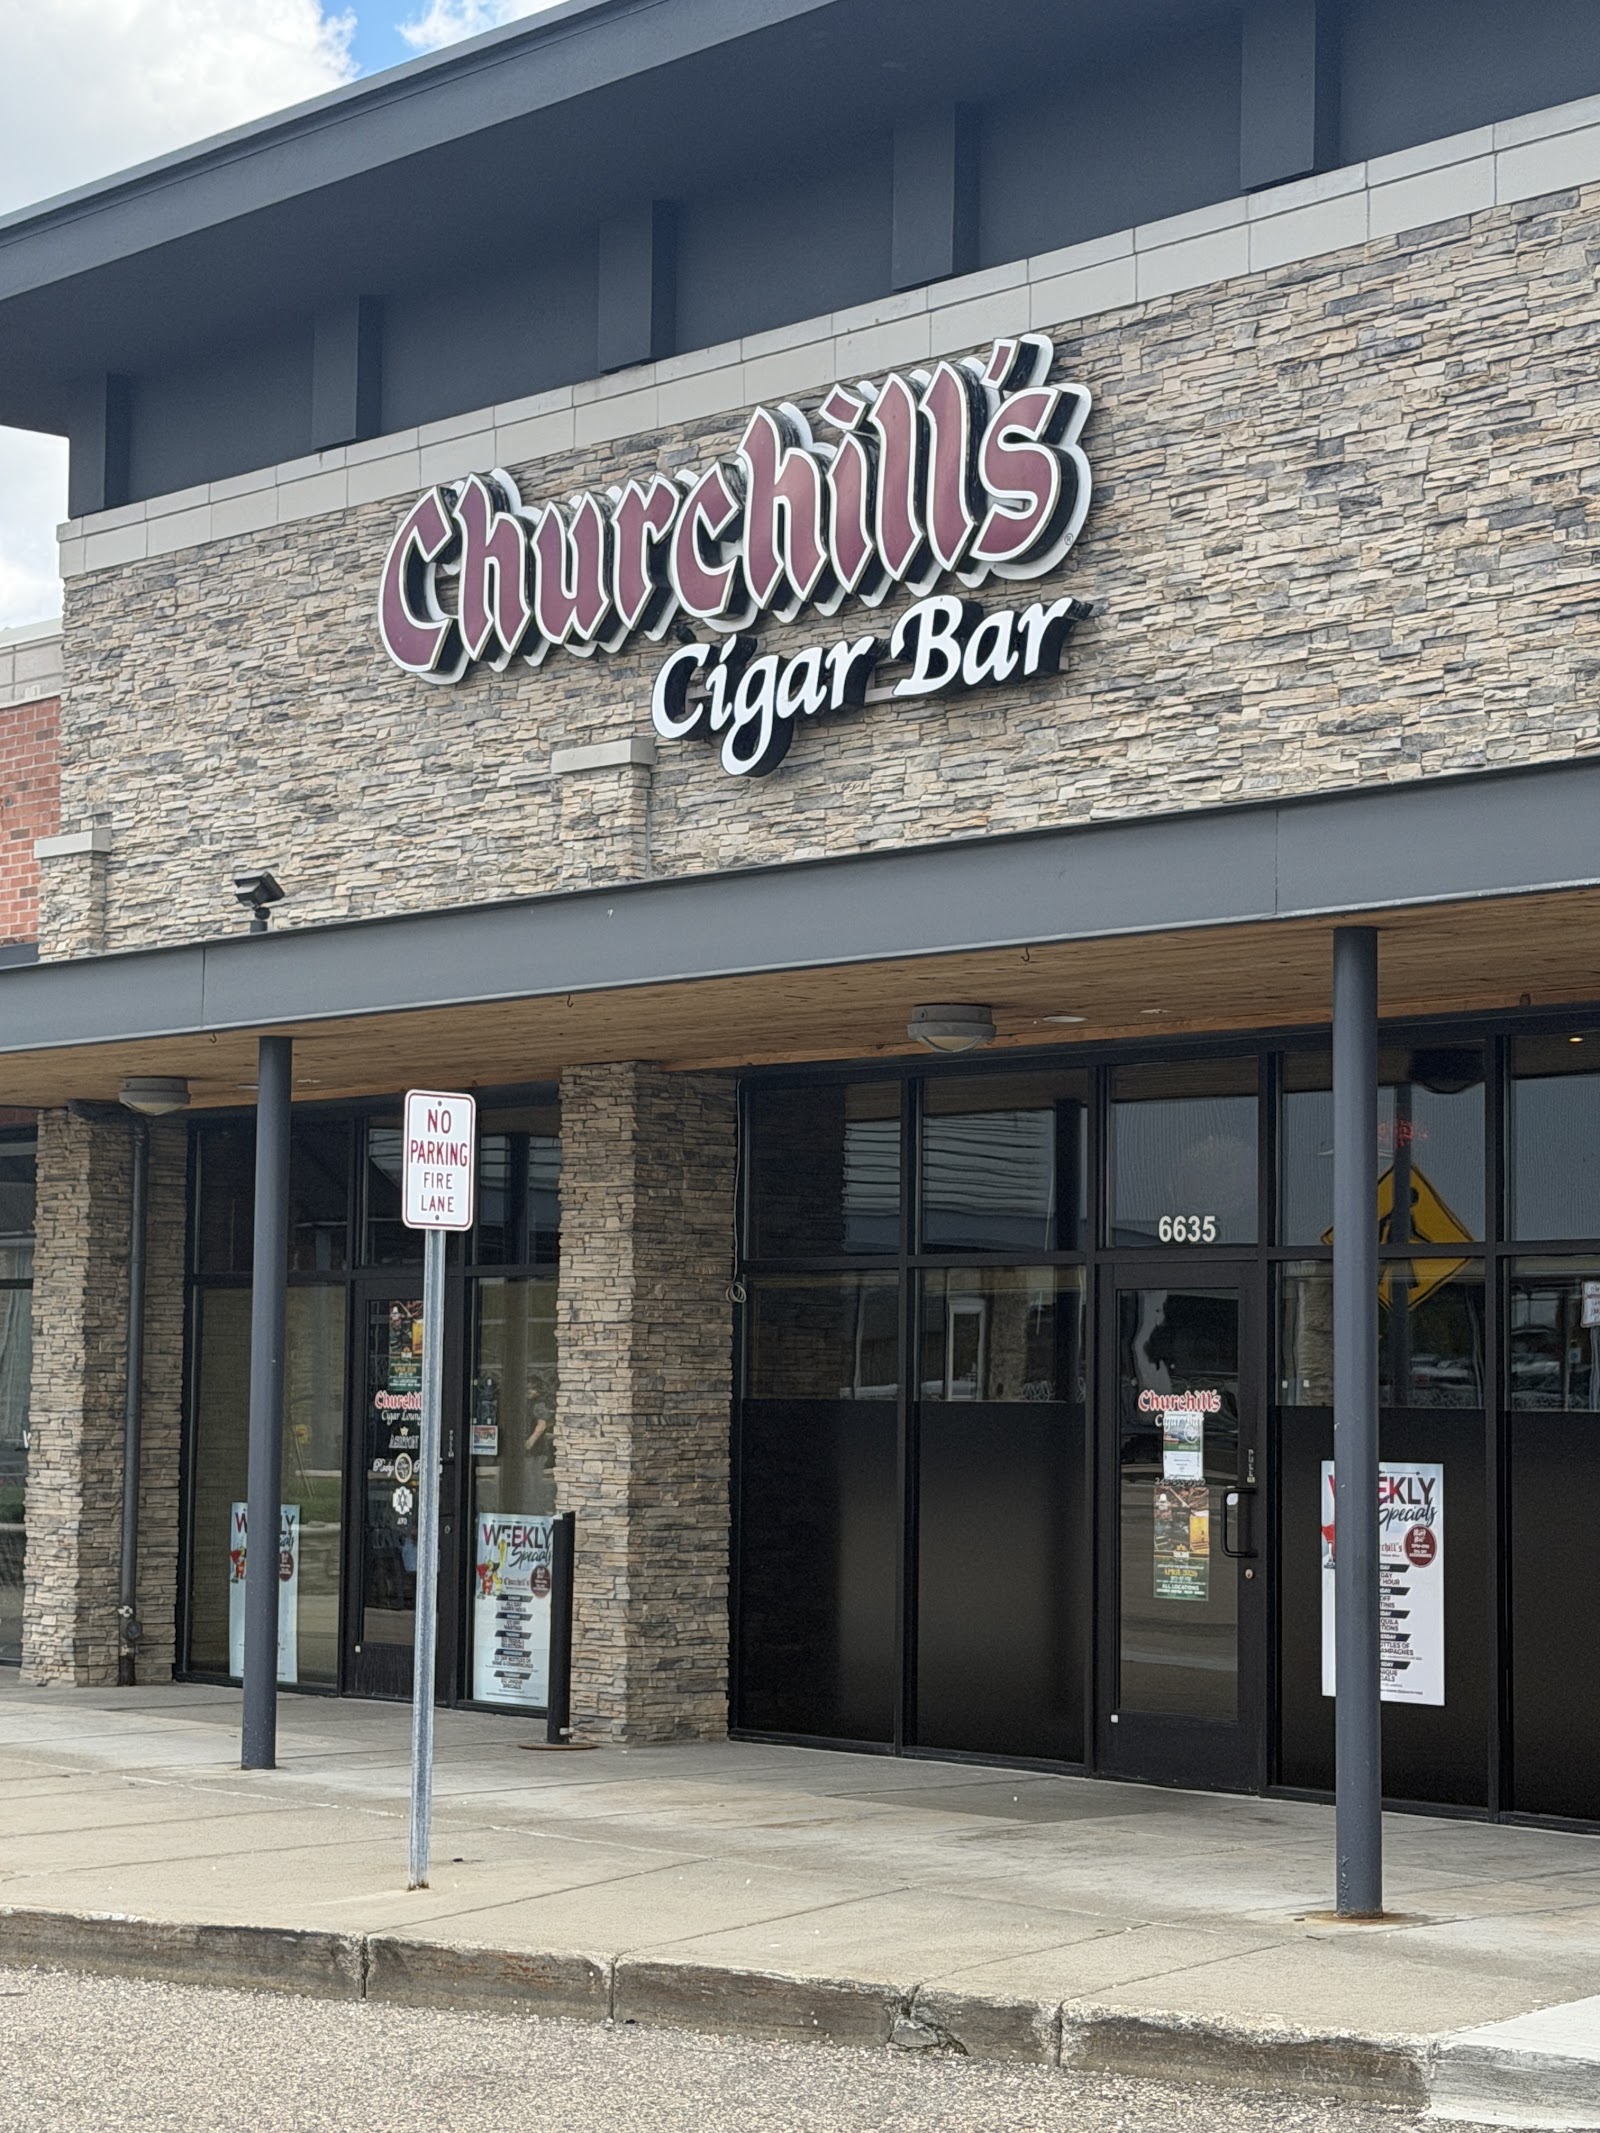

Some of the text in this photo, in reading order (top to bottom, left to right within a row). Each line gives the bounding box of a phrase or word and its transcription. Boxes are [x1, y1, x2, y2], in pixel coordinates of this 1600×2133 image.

[379, 337, 1062, 674] Churchill's
[652, 595, 1074, 777] Cigar Bar
[427, 1109, 452, 1134] NO
[410, 1139, 468, 1167] PARKING
[423, 1171, 453, 1190] FIRE
[420, 1194, 454, 1213] LANE
[1158, 1215, 1217, 1243] 6635
[375, 1389, 423, 1410] Churchil
[1138, 1389, 1221, 1412] Churchill's
[402, 1410, 423, 1427] Loung
[1247, 1448, 1255, 1477] PULL
[482, 1523, 553, 1549] WEEKLY
[1380, 1648, 1414, 1656] AMPAGNES
